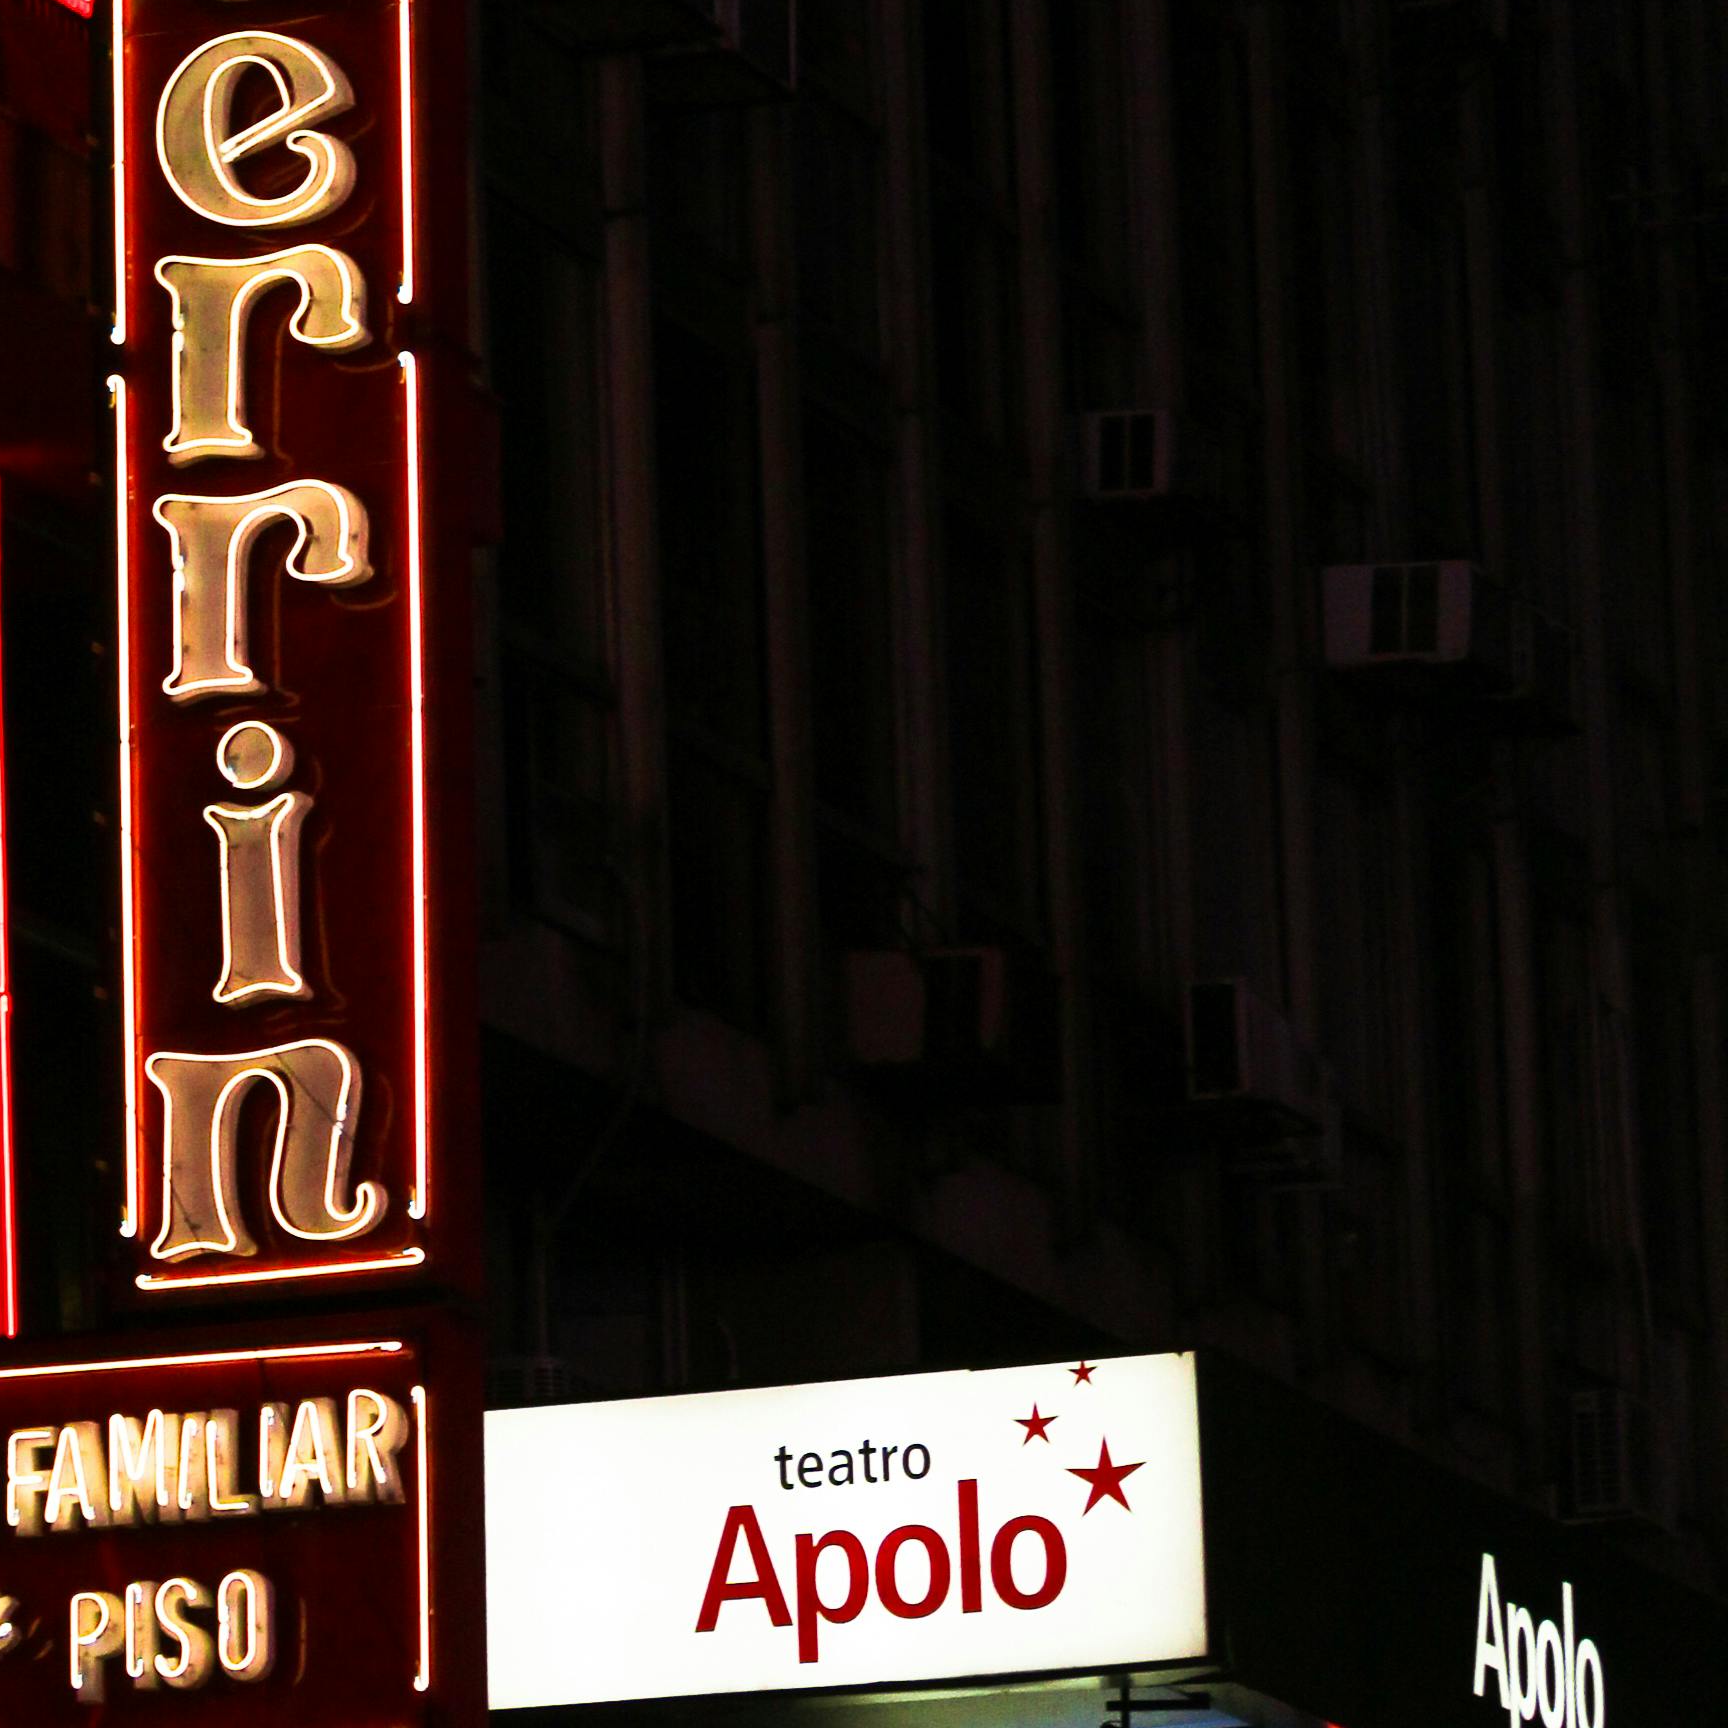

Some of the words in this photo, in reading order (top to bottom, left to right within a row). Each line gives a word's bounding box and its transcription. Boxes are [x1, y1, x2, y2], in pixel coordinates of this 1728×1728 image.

[5, 1388, 409, 1538] FAMILIAR
[774, 1438, 931, 1491] teatro
[69, 1569, 277, 1706] PISO
[695, 1478, 1067, 1664] Apolo
